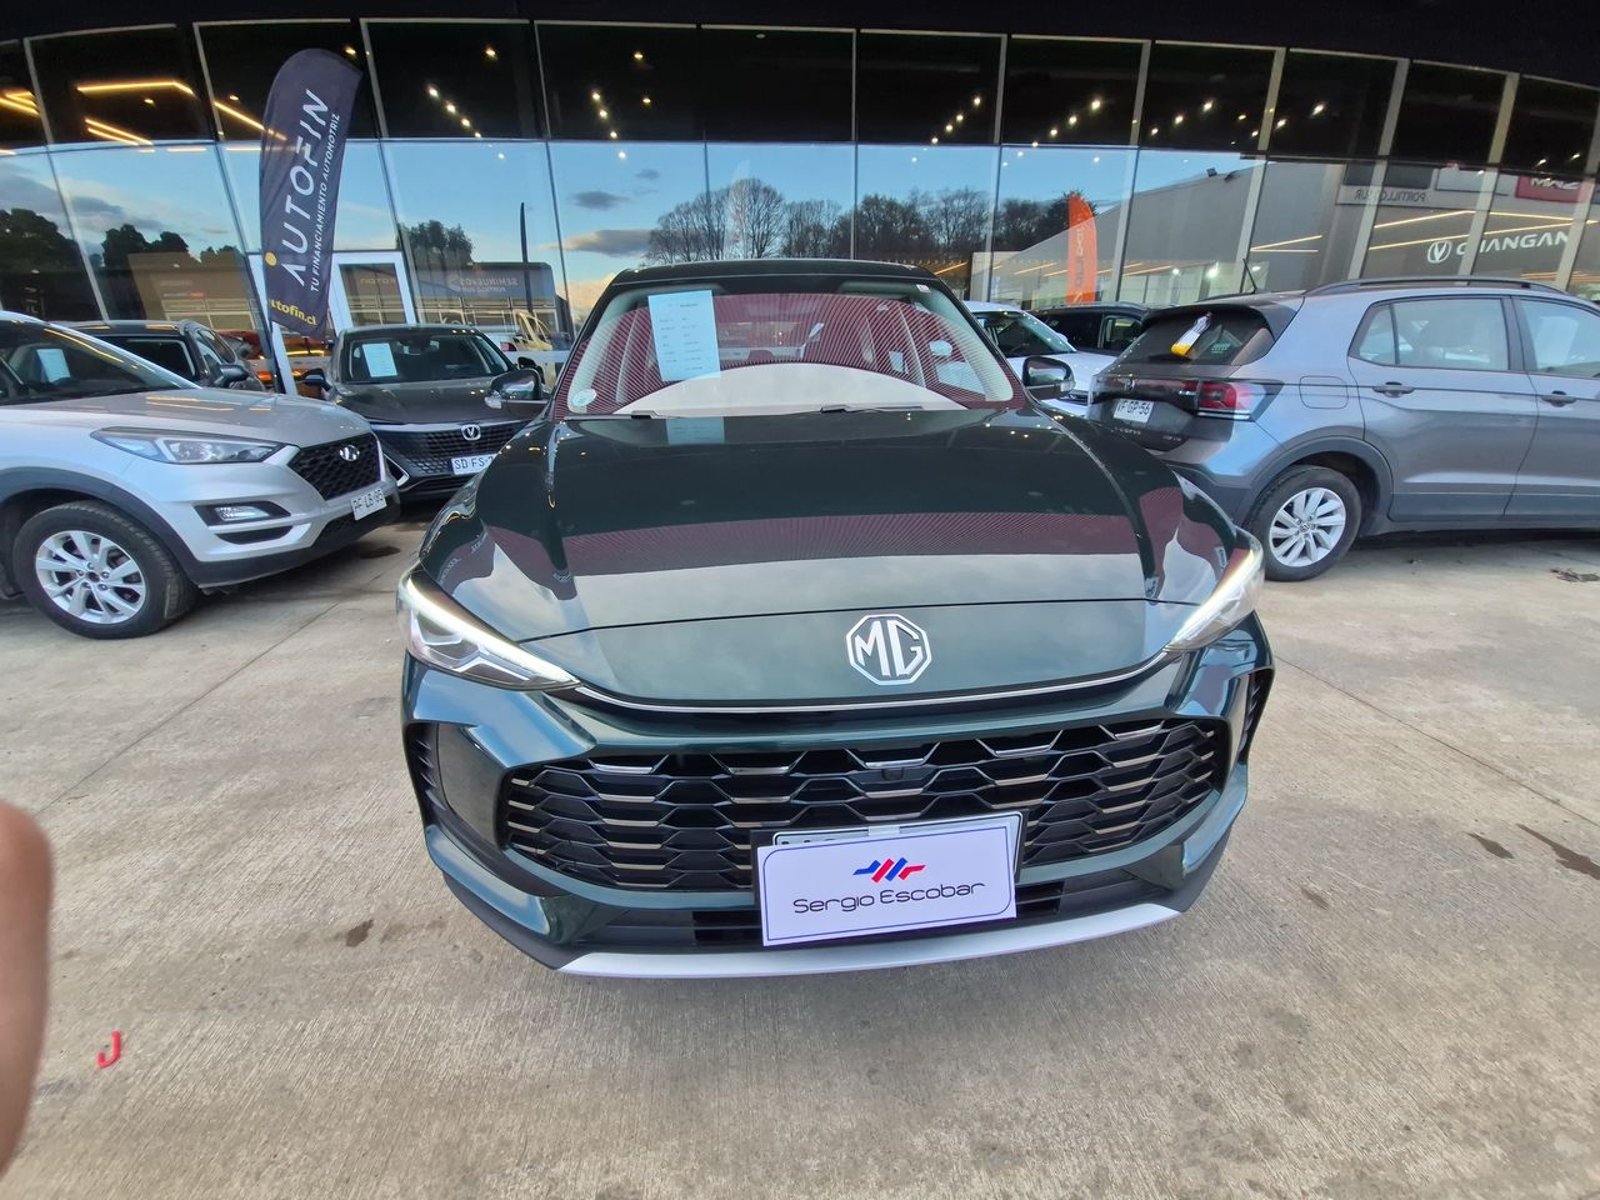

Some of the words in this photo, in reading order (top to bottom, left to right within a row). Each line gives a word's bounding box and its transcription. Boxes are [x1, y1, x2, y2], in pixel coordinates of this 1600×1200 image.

[324, 113, 341, 182] AUTOMOTRIZ
[281, 88, 329, 287] AUTOFIN
[311, 180, 328, 277] FINANCIAMIENTO
[310, 278, 321, 292] TU
[854, 619, 924, 677] MG
[793, 895, 875, 914] Sergio
[880, 882, 986, 905] Escobar
